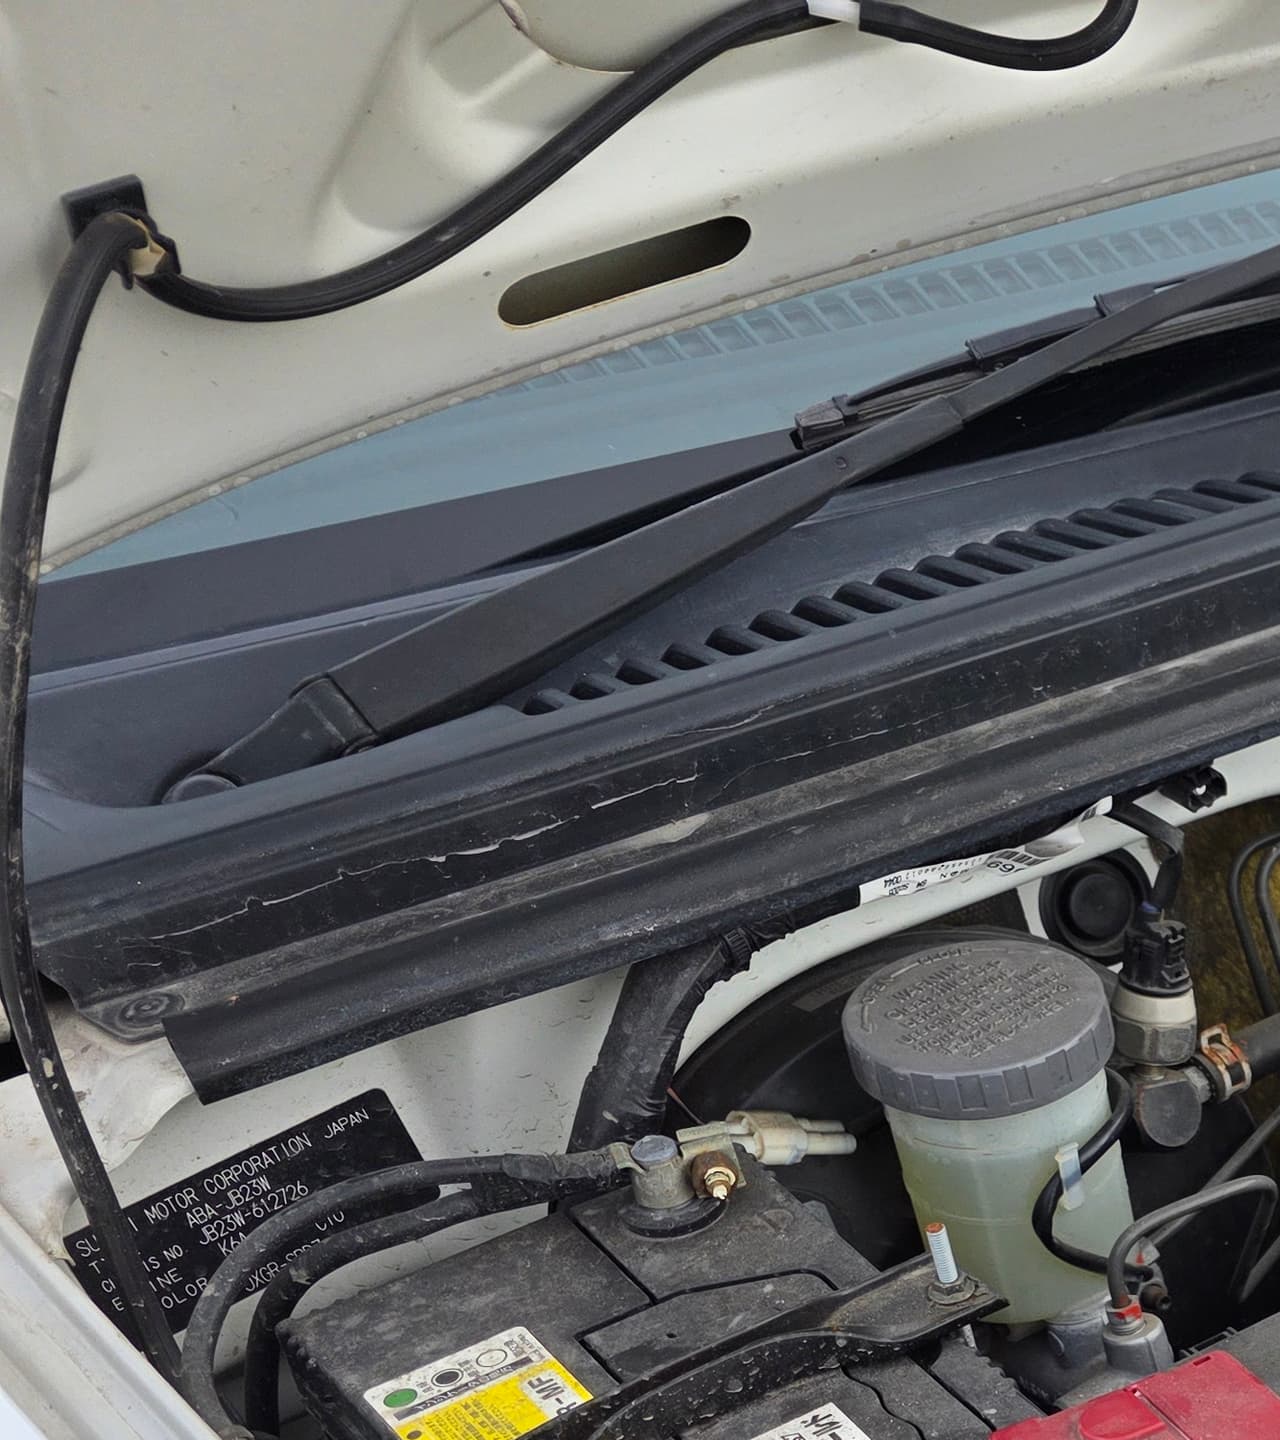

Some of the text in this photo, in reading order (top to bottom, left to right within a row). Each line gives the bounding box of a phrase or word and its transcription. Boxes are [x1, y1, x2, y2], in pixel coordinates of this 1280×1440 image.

[144, 1187, 201, 1224] MOTOR
[203, 1131, 312, 1195] CORPORATION
[324, 1108, 369, 1140] JAPAN
[186, 1174, 272, 1229] ABA-JB23W
[199, 1180, 309, 1246] JB23W-612726
